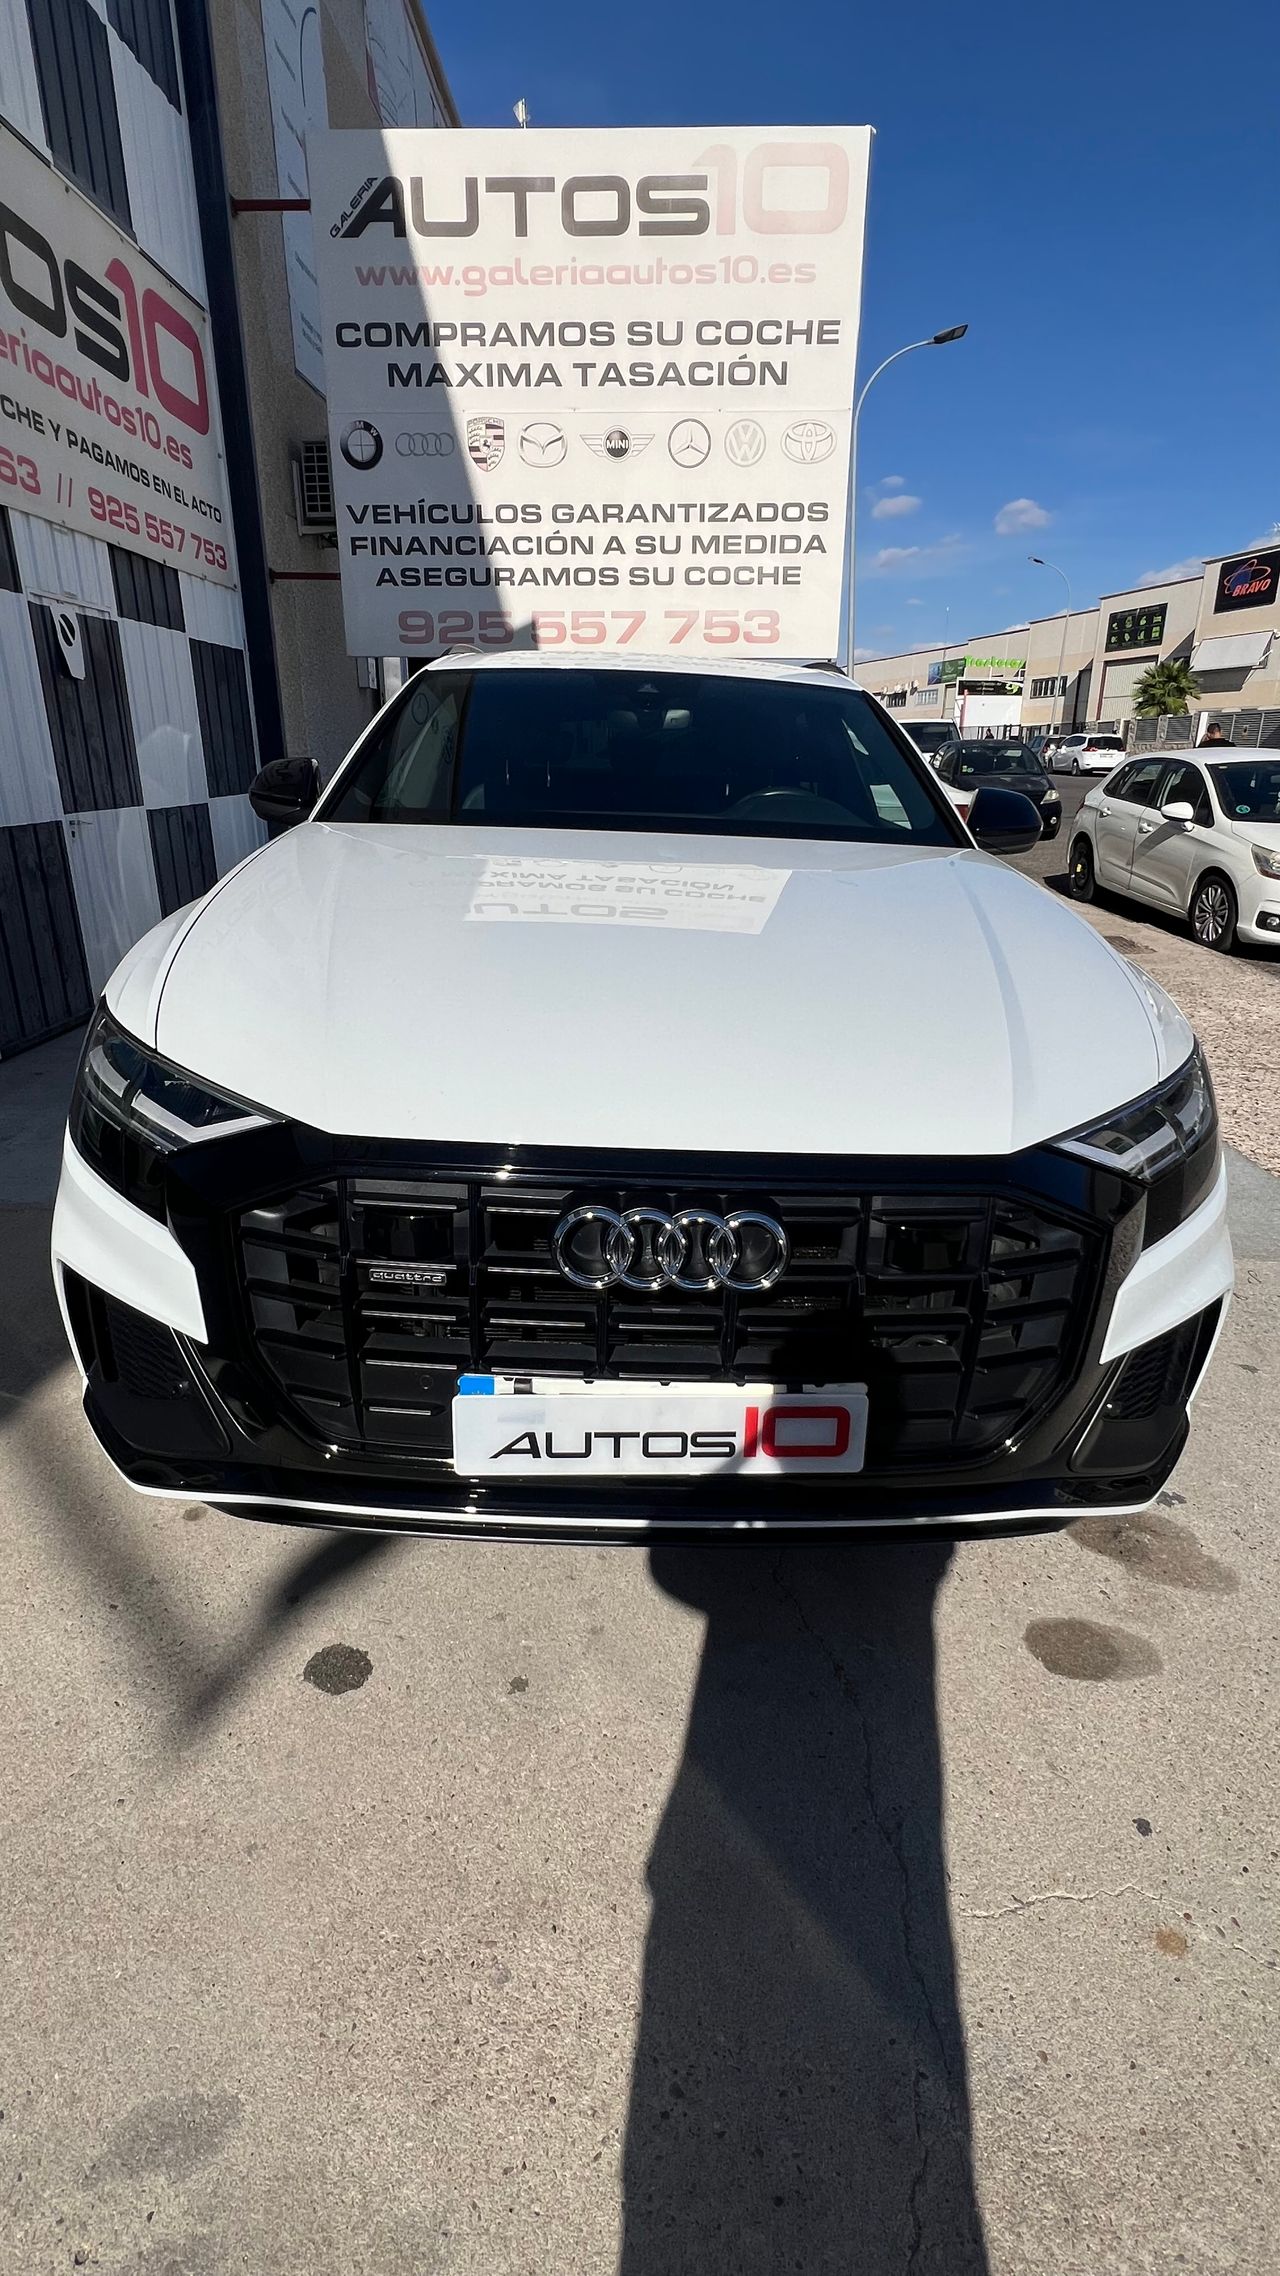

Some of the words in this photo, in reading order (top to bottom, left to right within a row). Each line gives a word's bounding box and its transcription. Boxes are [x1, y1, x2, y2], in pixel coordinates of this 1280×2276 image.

[329, 176, 379, 239] GALERIA
[340, 142, 849, 238] AUTOS10
[355, 254, 817, 297] www.galeriaautos10.es
[335, 321, 615, 348] COMPRAMOS
[627, 321, 689, 346] SU
[696, 319, 841, 346] COCHE
[387, 361, 563, 388] MAXIMA
[573, 353, 789, 387] TASACIÓN
[606, 439, 629, 449] MINI
[48, 418, 61, 442] Y
[66, 428, 151, 488] PAGAMOS
[153, 474, 172, 500] EN
[173, 485, 190, 508] EL
[191, 496, 222, 524] ACTO
[88, 486, 140, 535] 925
[144, 511, 185, 553] 557
[190, 532, 228, 571] 753
[346, 498, 542, 525] VEHÍCULOS
[551, 501, 830, 524] GARANTIZADOS
[350, 530, 595, 556] FINANCIACIÓN
[602, 534, 627, 555] A
[635, 534, 681, 555] SU
[691, 534, 828, 555] MEDIDA
[375, 566, 619, 587] ASEGURAMOS
[628, 566, 675, 586] SU
[684, 565, 802, 586] COCHE
[1231, 579, 1272, 597] BRAVO
[398, 610, 514, 645] 925
[531, 610, 647, 645] 557
[665, 609, 781, 644] 753
[372, 1272, 443, 1282] quattro
[489, 1406, 851, 1459] AUTOS10
